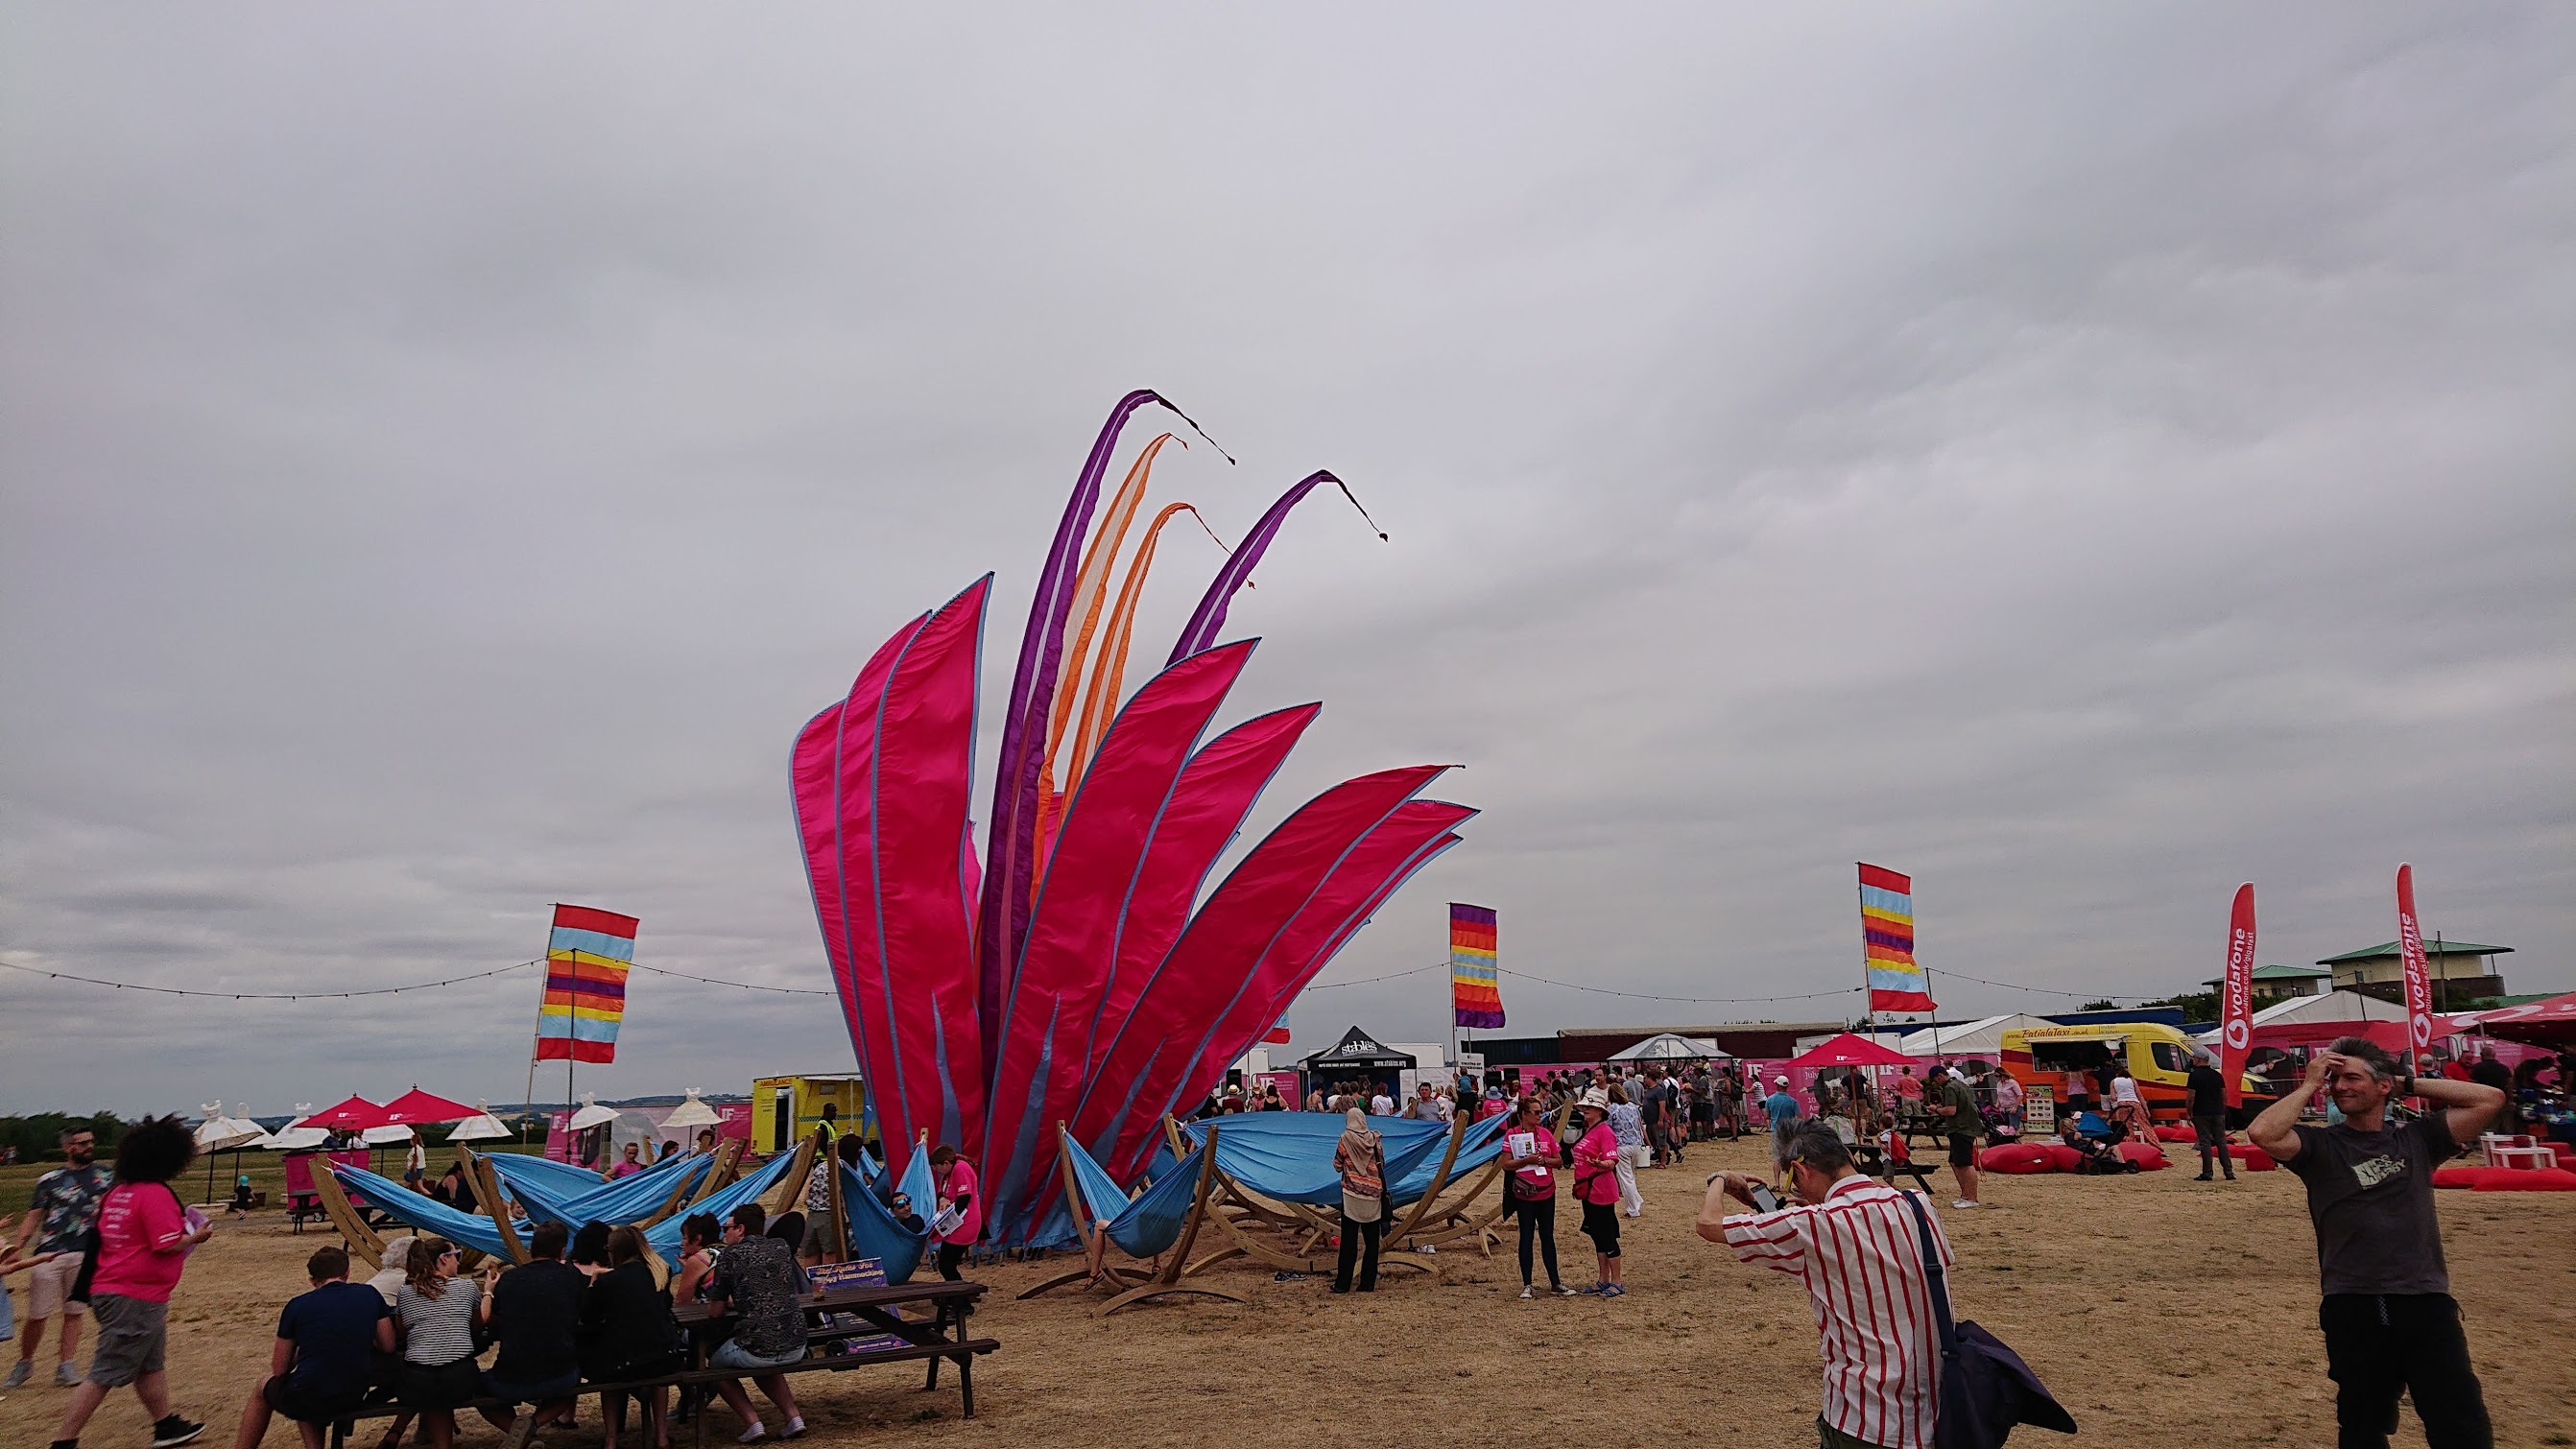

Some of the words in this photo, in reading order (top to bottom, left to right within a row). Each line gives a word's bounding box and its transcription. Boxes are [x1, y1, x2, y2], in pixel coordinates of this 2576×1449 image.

[2227, 927, 2246, 1017] vodafone
[1747, 1063, 1764, 1079] IF
[1804, 1071, 1820, 1080] July
[759, 1078, 794, 1087] AMBULANCE
[839, 1269, 885, 1281] Hammocking
